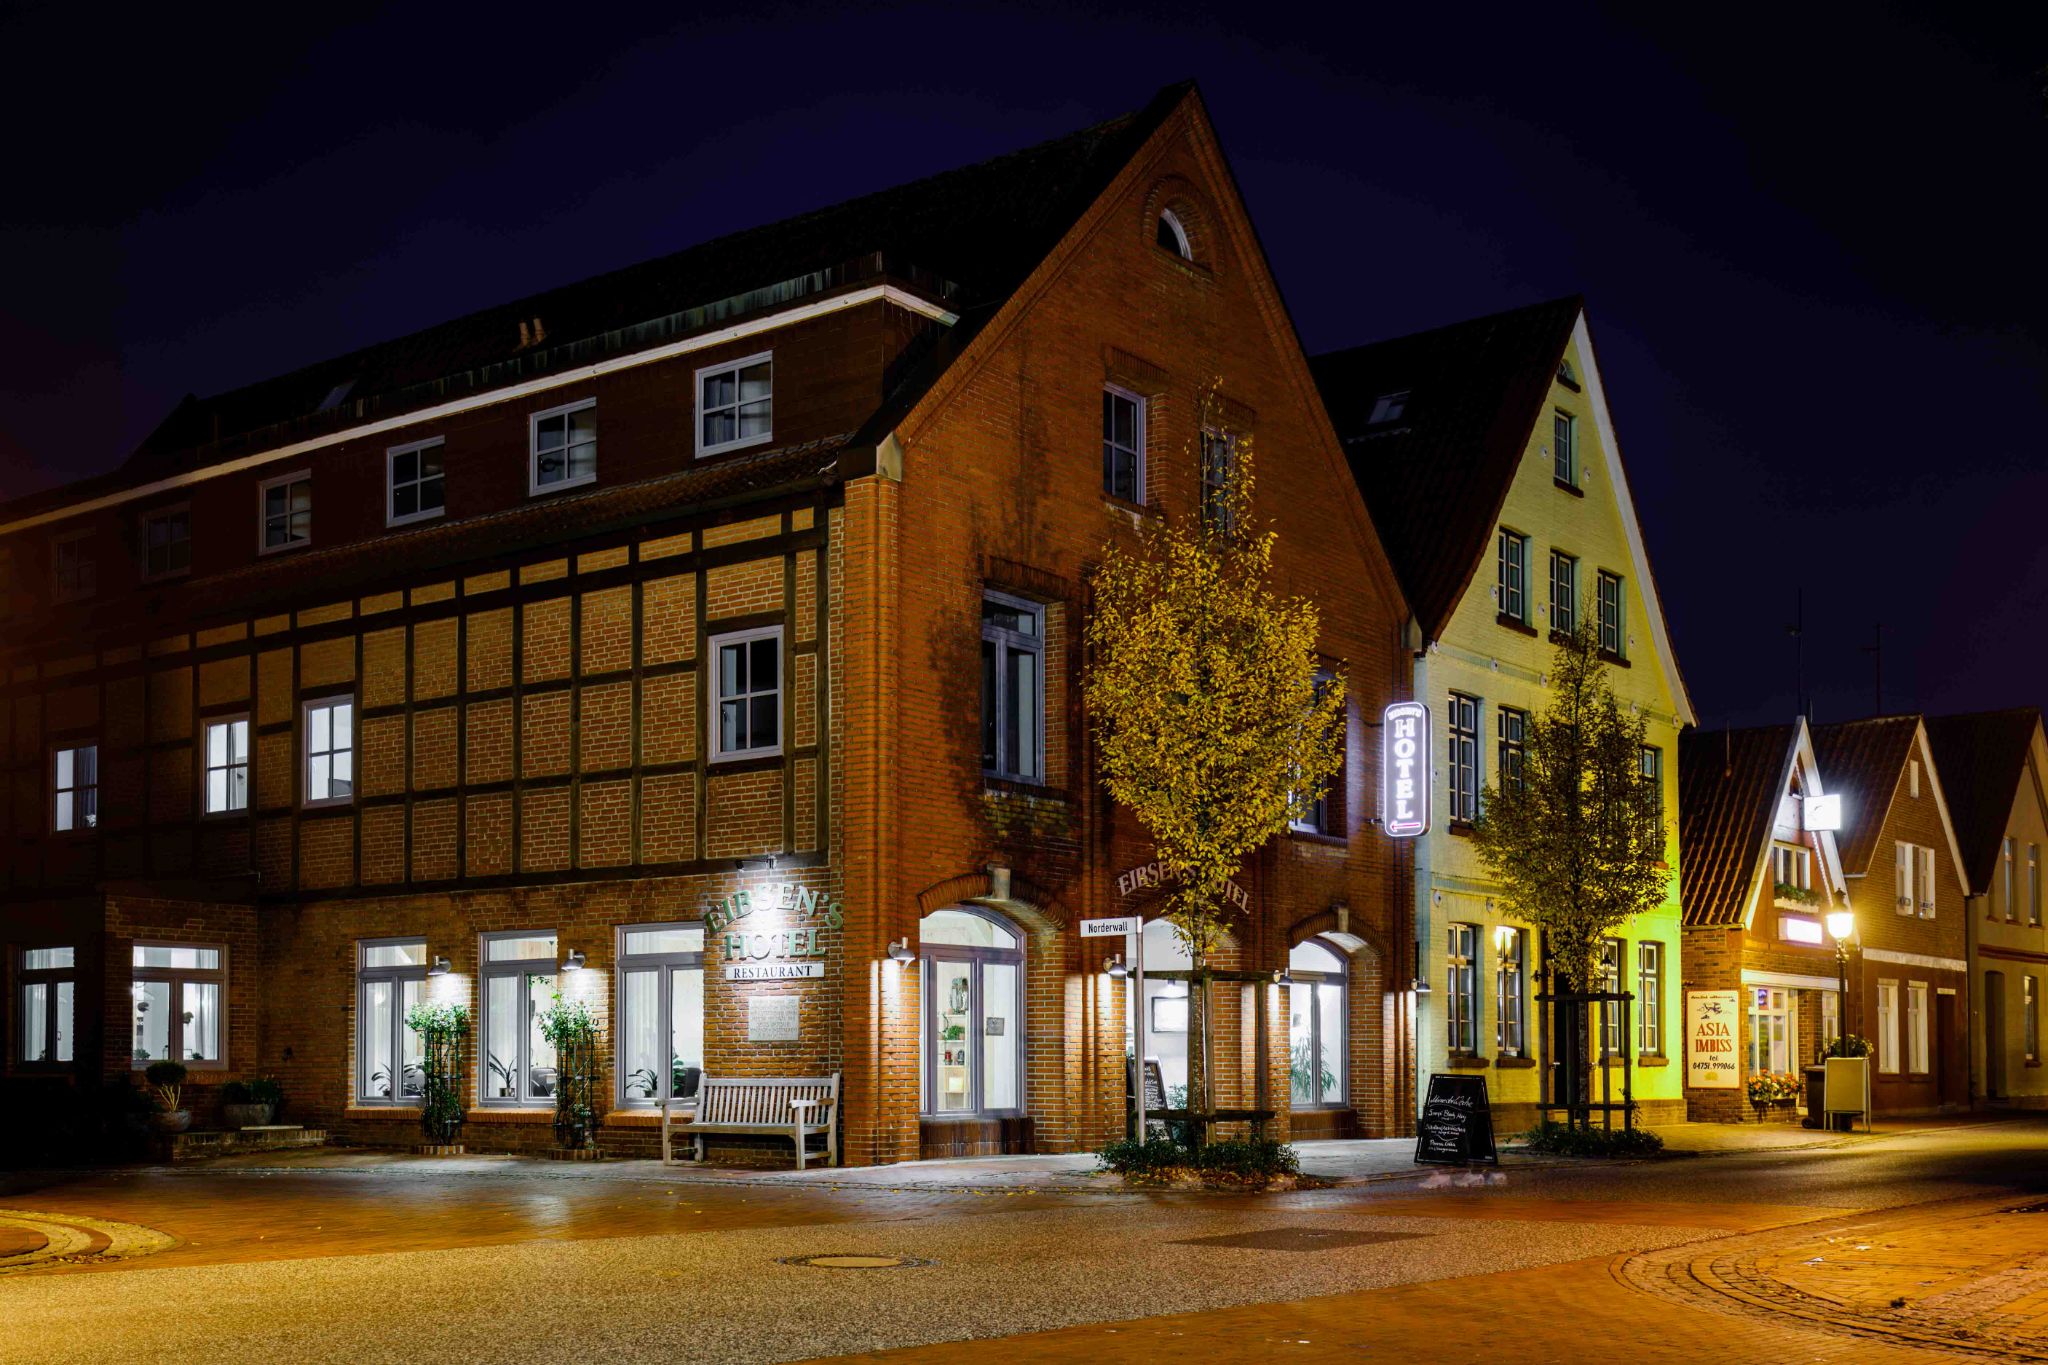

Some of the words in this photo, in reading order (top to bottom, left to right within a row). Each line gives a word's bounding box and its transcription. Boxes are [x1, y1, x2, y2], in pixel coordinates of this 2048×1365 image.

[1394, 718, 1416, 819] HOTEL
[1088, 921, 1128, 934] Norderwall
[724, 929, 826, 959] HOTEL
[734, 965, 813, 979] RESTAURANT
[1696, 1021, 1731, 1036] ASIA
[1695, 1038, 1732, 1053] IMBISS
